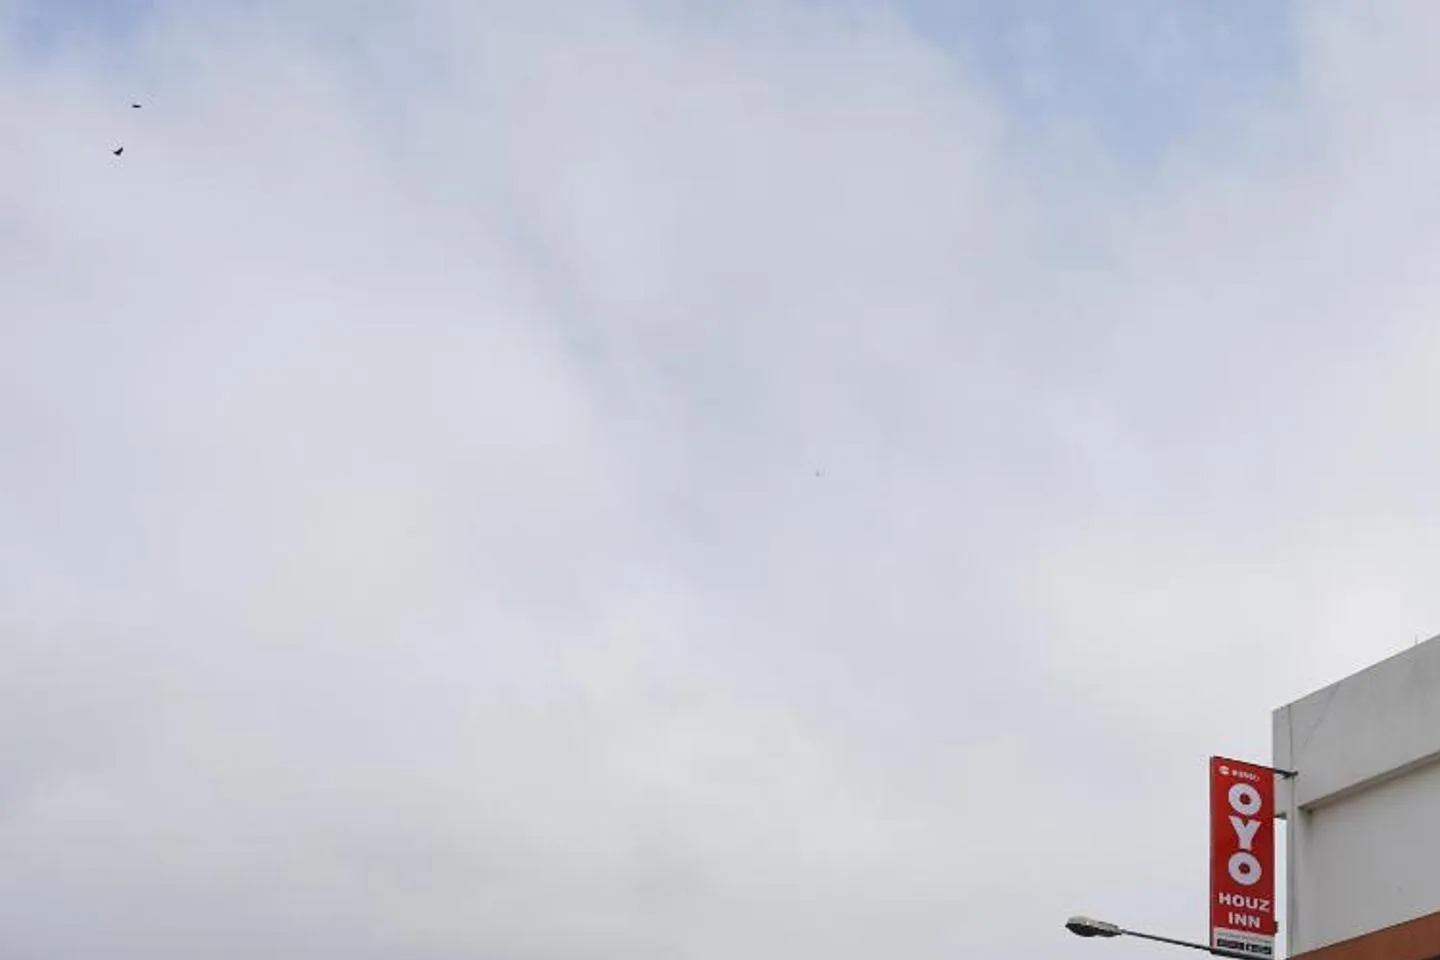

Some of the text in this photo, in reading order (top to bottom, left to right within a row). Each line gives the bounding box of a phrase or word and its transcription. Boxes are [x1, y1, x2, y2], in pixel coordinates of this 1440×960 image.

[1228, 783, 1262, 886] OYO
[1218, 892, 1271, 912] HOUZ
[1228, 911, 1260, 929] INN
